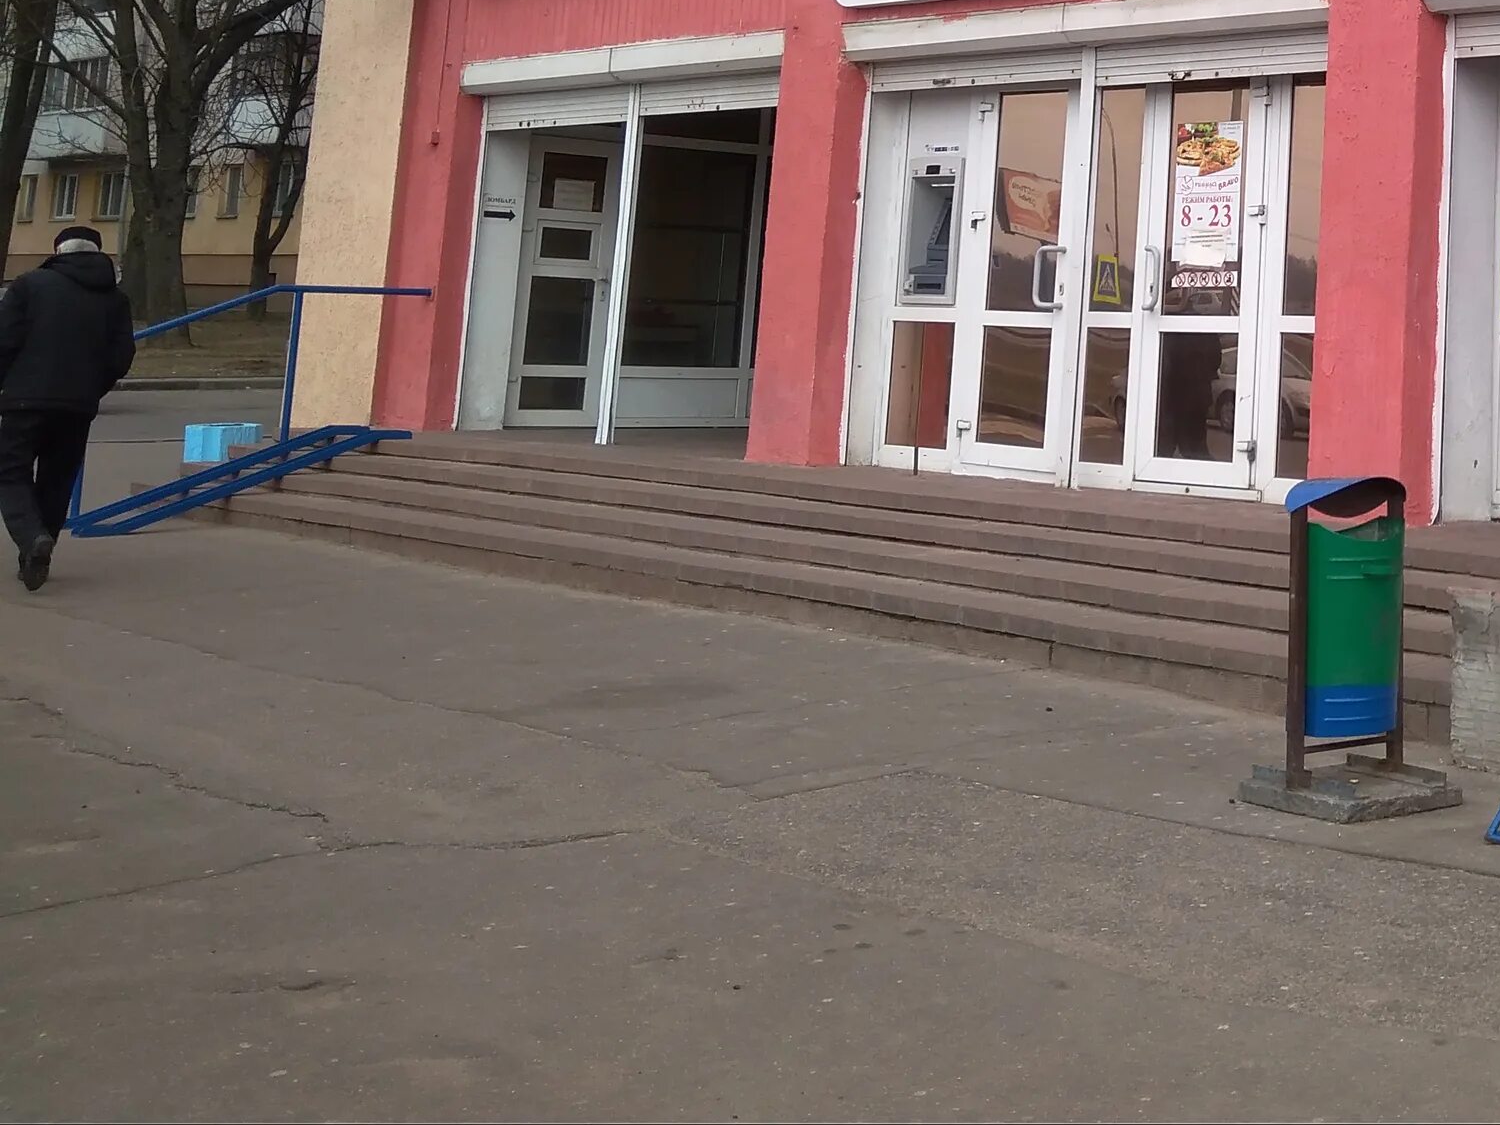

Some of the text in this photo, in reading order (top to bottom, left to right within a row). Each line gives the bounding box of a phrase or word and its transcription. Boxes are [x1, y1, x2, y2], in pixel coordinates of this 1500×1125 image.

[1181, 196, 1205, 204] РЕЖИМ
[1181, 204, 1191, 227] 8
[1208, 204, 1232, 227] 23
